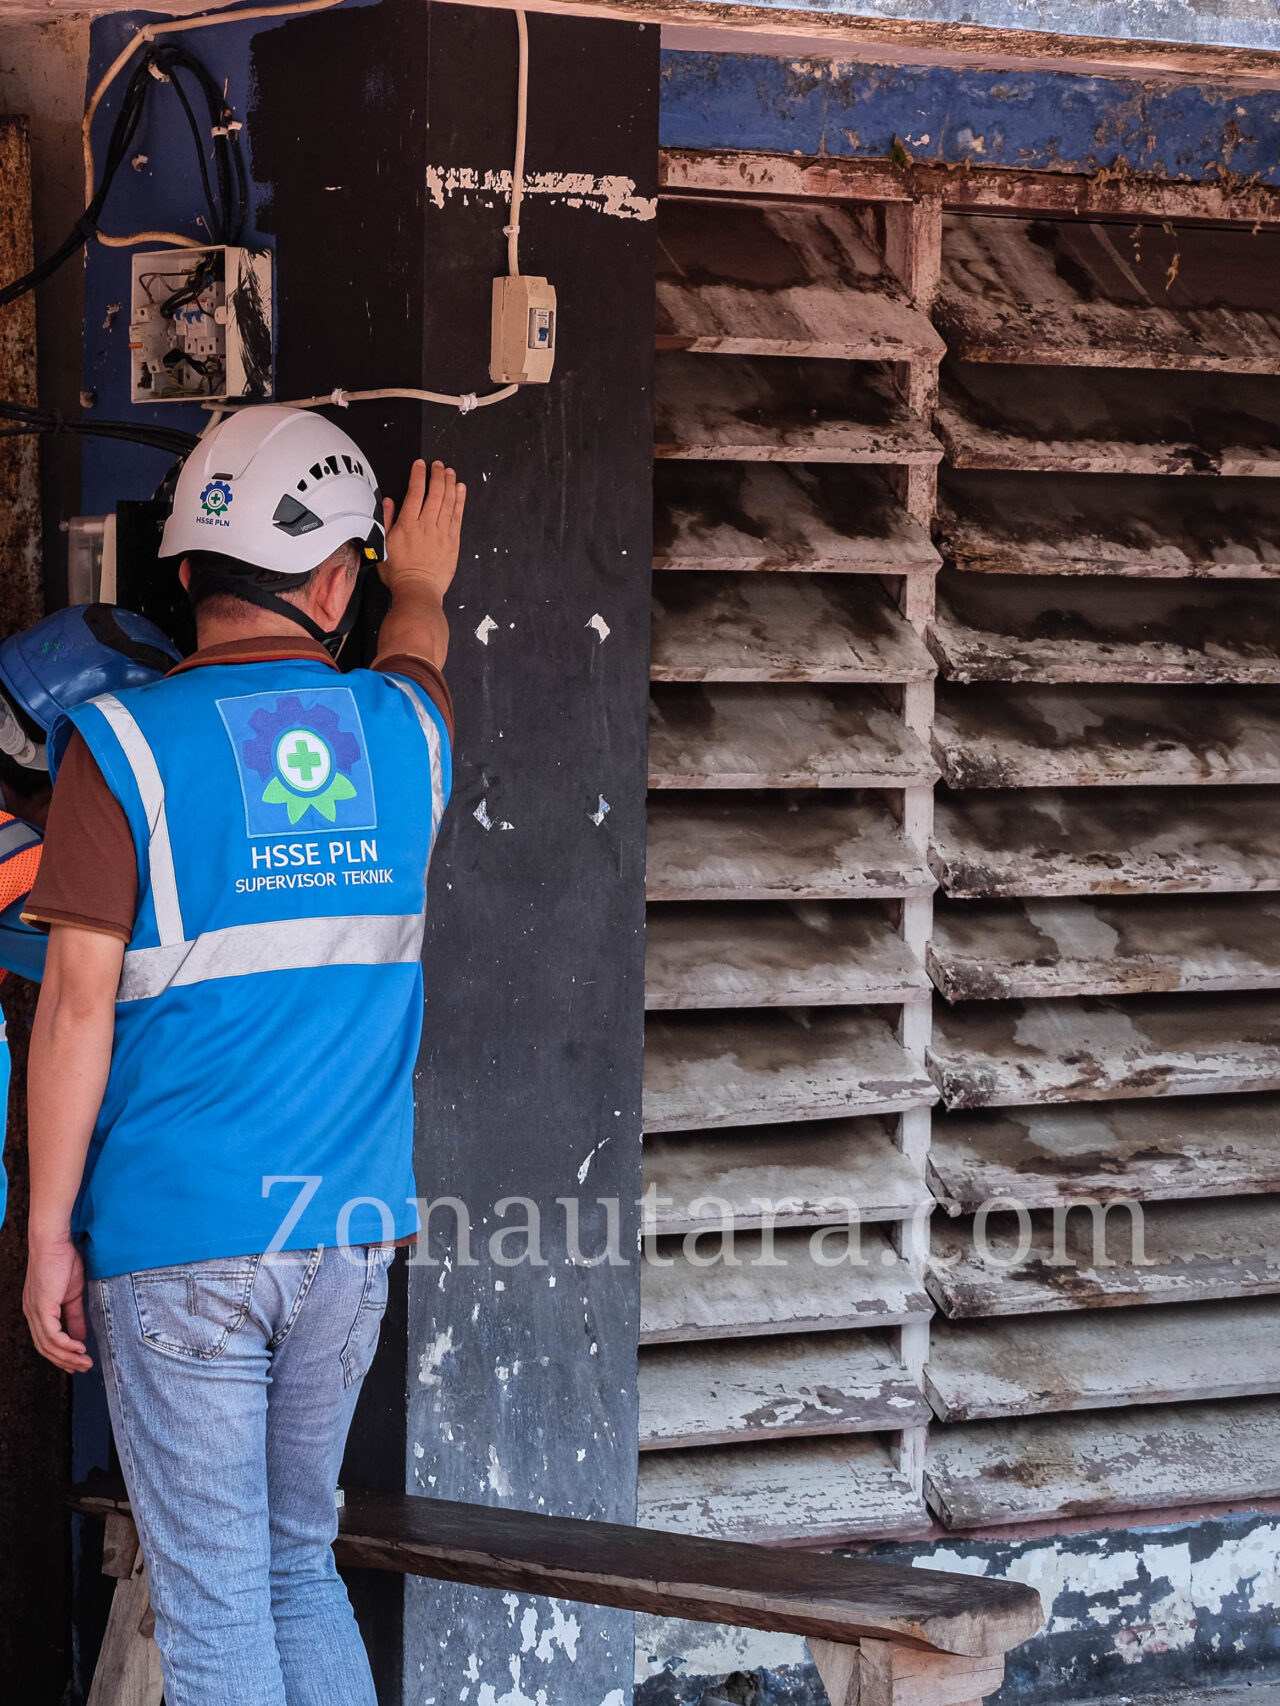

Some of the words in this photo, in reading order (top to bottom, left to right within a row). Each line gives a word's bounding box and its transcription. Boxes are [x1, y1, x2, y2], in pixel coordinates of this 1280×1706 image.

[195, 516, 214, 525] HSSE
[214, 519, 230, 527] PLN
[250, 842, 322, 870] HSSE
[328, 839, 379, 865] PLN
[234, 872, 338, 894] SUPERVISOR
[341, 868, 394, 886] TEKNIK
